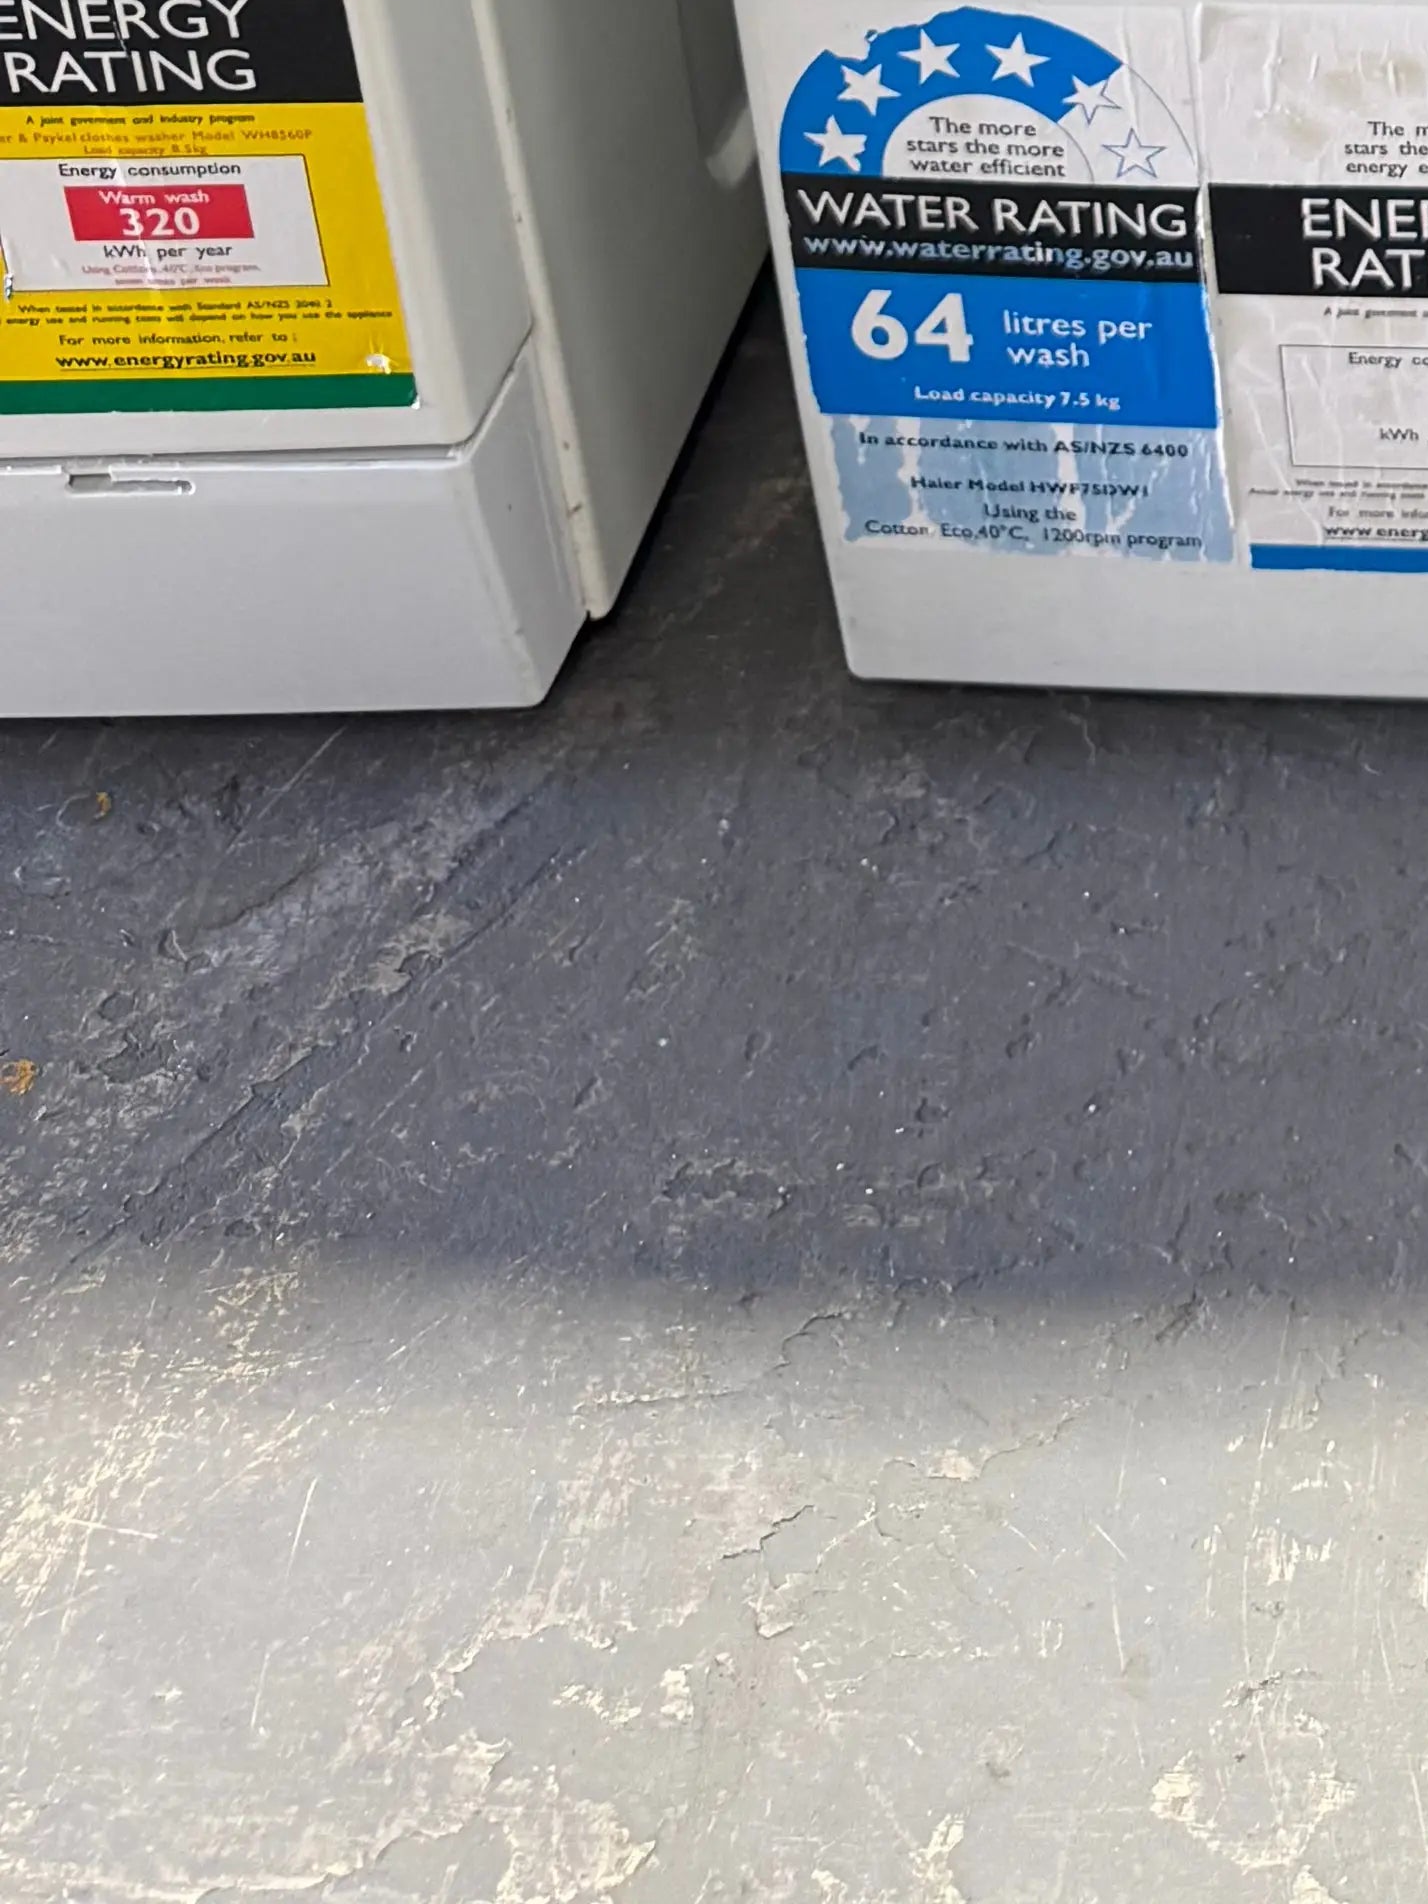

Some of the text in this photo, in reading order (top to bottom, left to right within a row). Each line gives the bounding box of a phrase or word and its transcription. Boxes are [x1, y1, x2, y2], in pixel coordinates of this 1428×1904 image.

[4, 50, 256, 93] RATING
[929, 117, 1037, 137] The more
[1367, 121, 1405, 137] The
[907, 139, 1065, 158] stars the more
[1344, 143, 1388, 156] stars
[1399, 142, 1428, 157] the
[58, 162, 241, 179] Energy consumption
[910, 158, 1066, 177] water efficient
[1346, 162, 1408, 178] energy
[98, 190, 209, 204] Warm wash
[120, 208, 200, 236] 320
[797, 189, 1188, 240] WATER RATING
[104, 245, 232, 261] kWh per year
[804, 237, 1193, 272] www.waterrating.gov.au
[851, 289, 1153, 363] 64 litres per
[60, 335, 83, 346] For
[92, 335, 130, 345] more
[230, 332, 262, 343] refer
[56, 351, 316, 370] www.energyrating.gov.au
[1007, 344, 1090, 368] wash
[1348, 352, 1402, 369] Energy
[914, 386, 1121, 411] Load capacity 7.5 kg
[859, 432, 1188, 457] In accordance with AS/NZS 6400
[1379, 429, 1419, 442] kWh
[911, 476, 962, 489] Haier
[969, 479, 1024, 492] Model
[984, 504, 1076, 523] Using the
[1127, 534, 1202, 549] program
